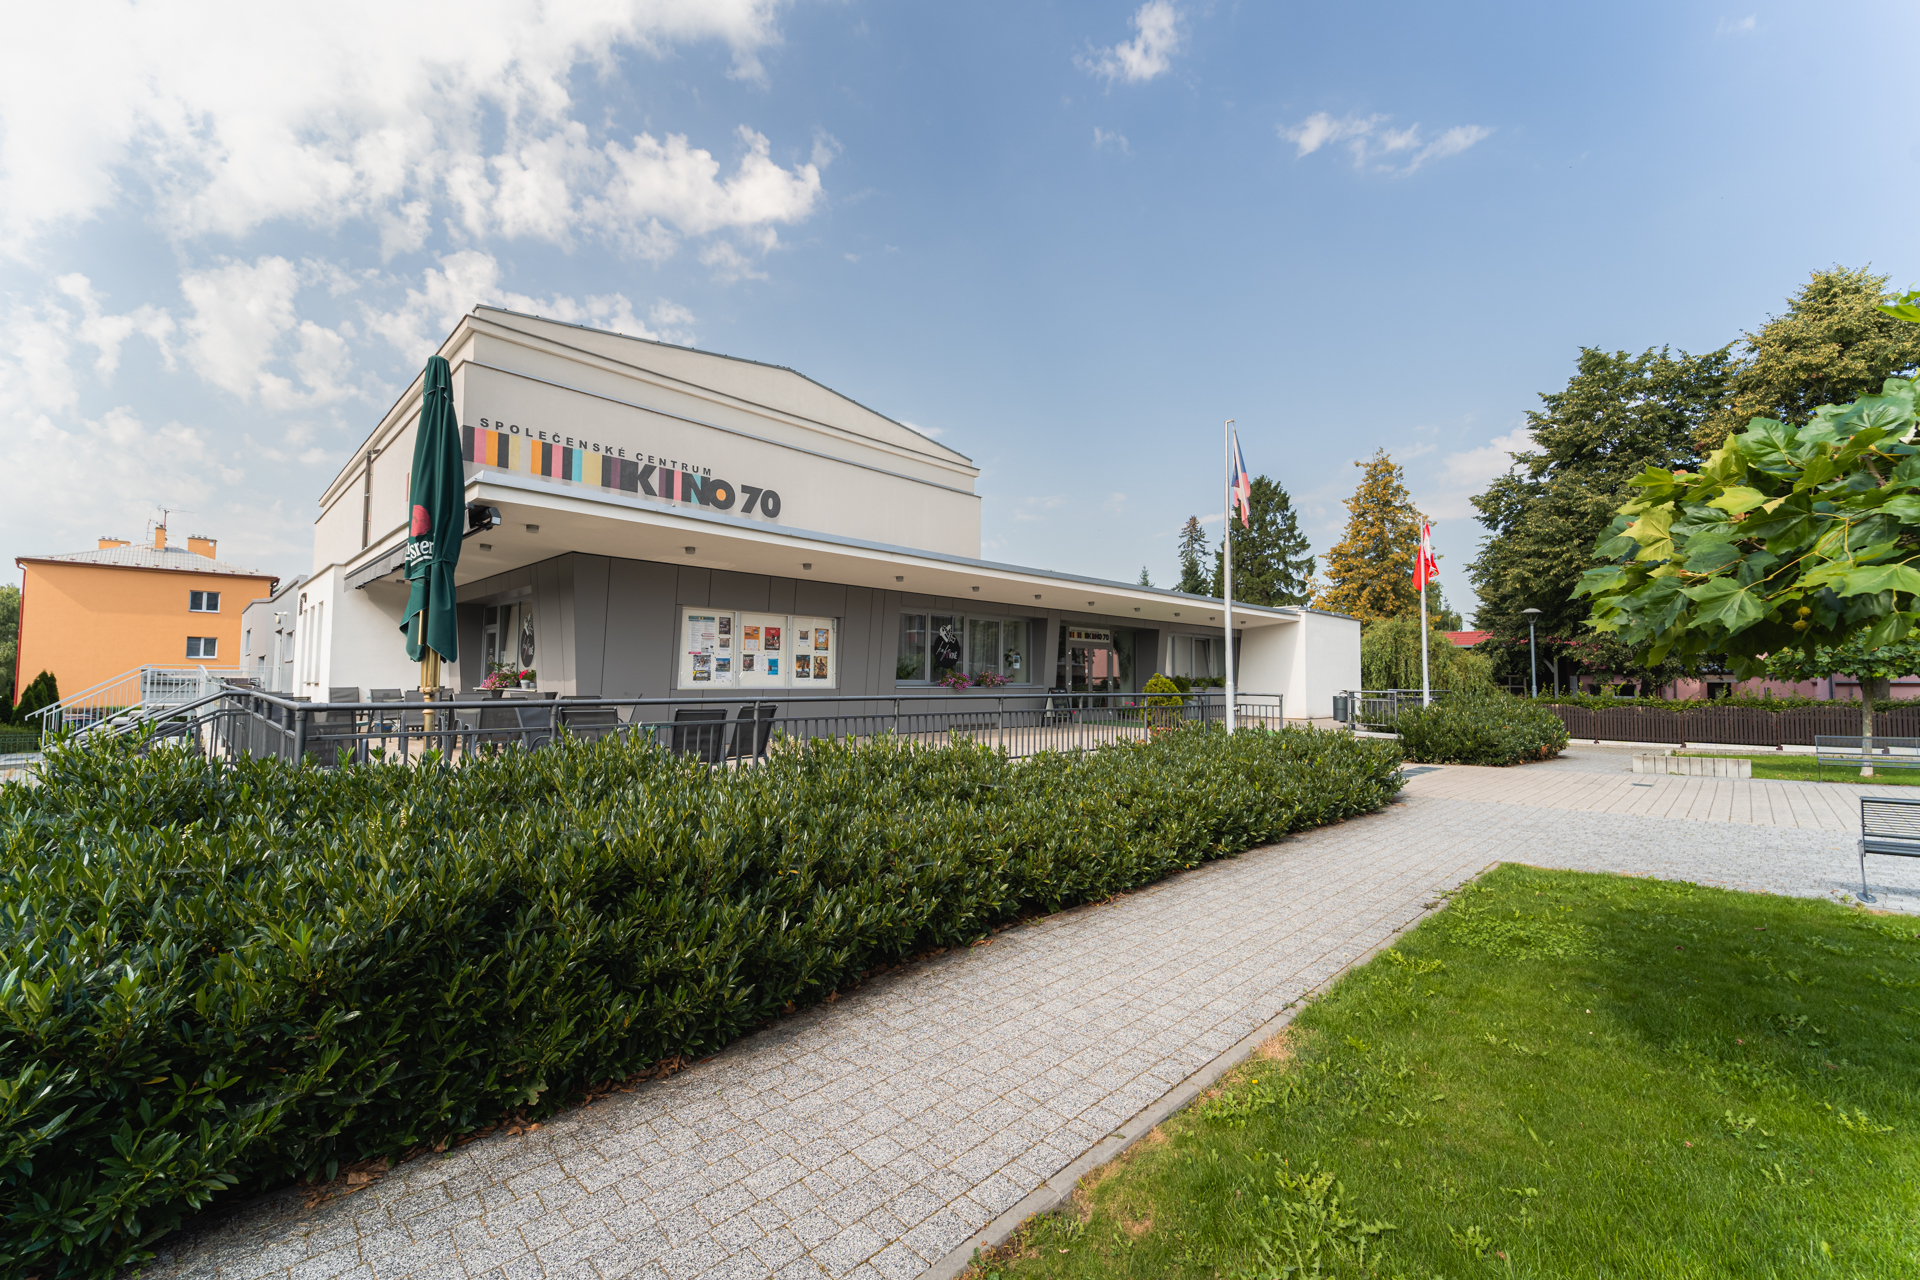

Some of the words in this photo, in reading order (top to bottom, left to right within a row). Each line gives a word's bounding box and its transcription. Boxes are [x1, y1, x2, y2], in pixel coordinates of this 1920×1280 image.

[480, 417, 626, 458] SPOLEČENSKÉ
[635, 452, 711, 476] CENTRUM
[620, 461, 735, 510] KINO
[740, 484, 781, 518] 70
[1087, 632, 1102, 640] KINO
[1103, 633, 1109, 641] 70
